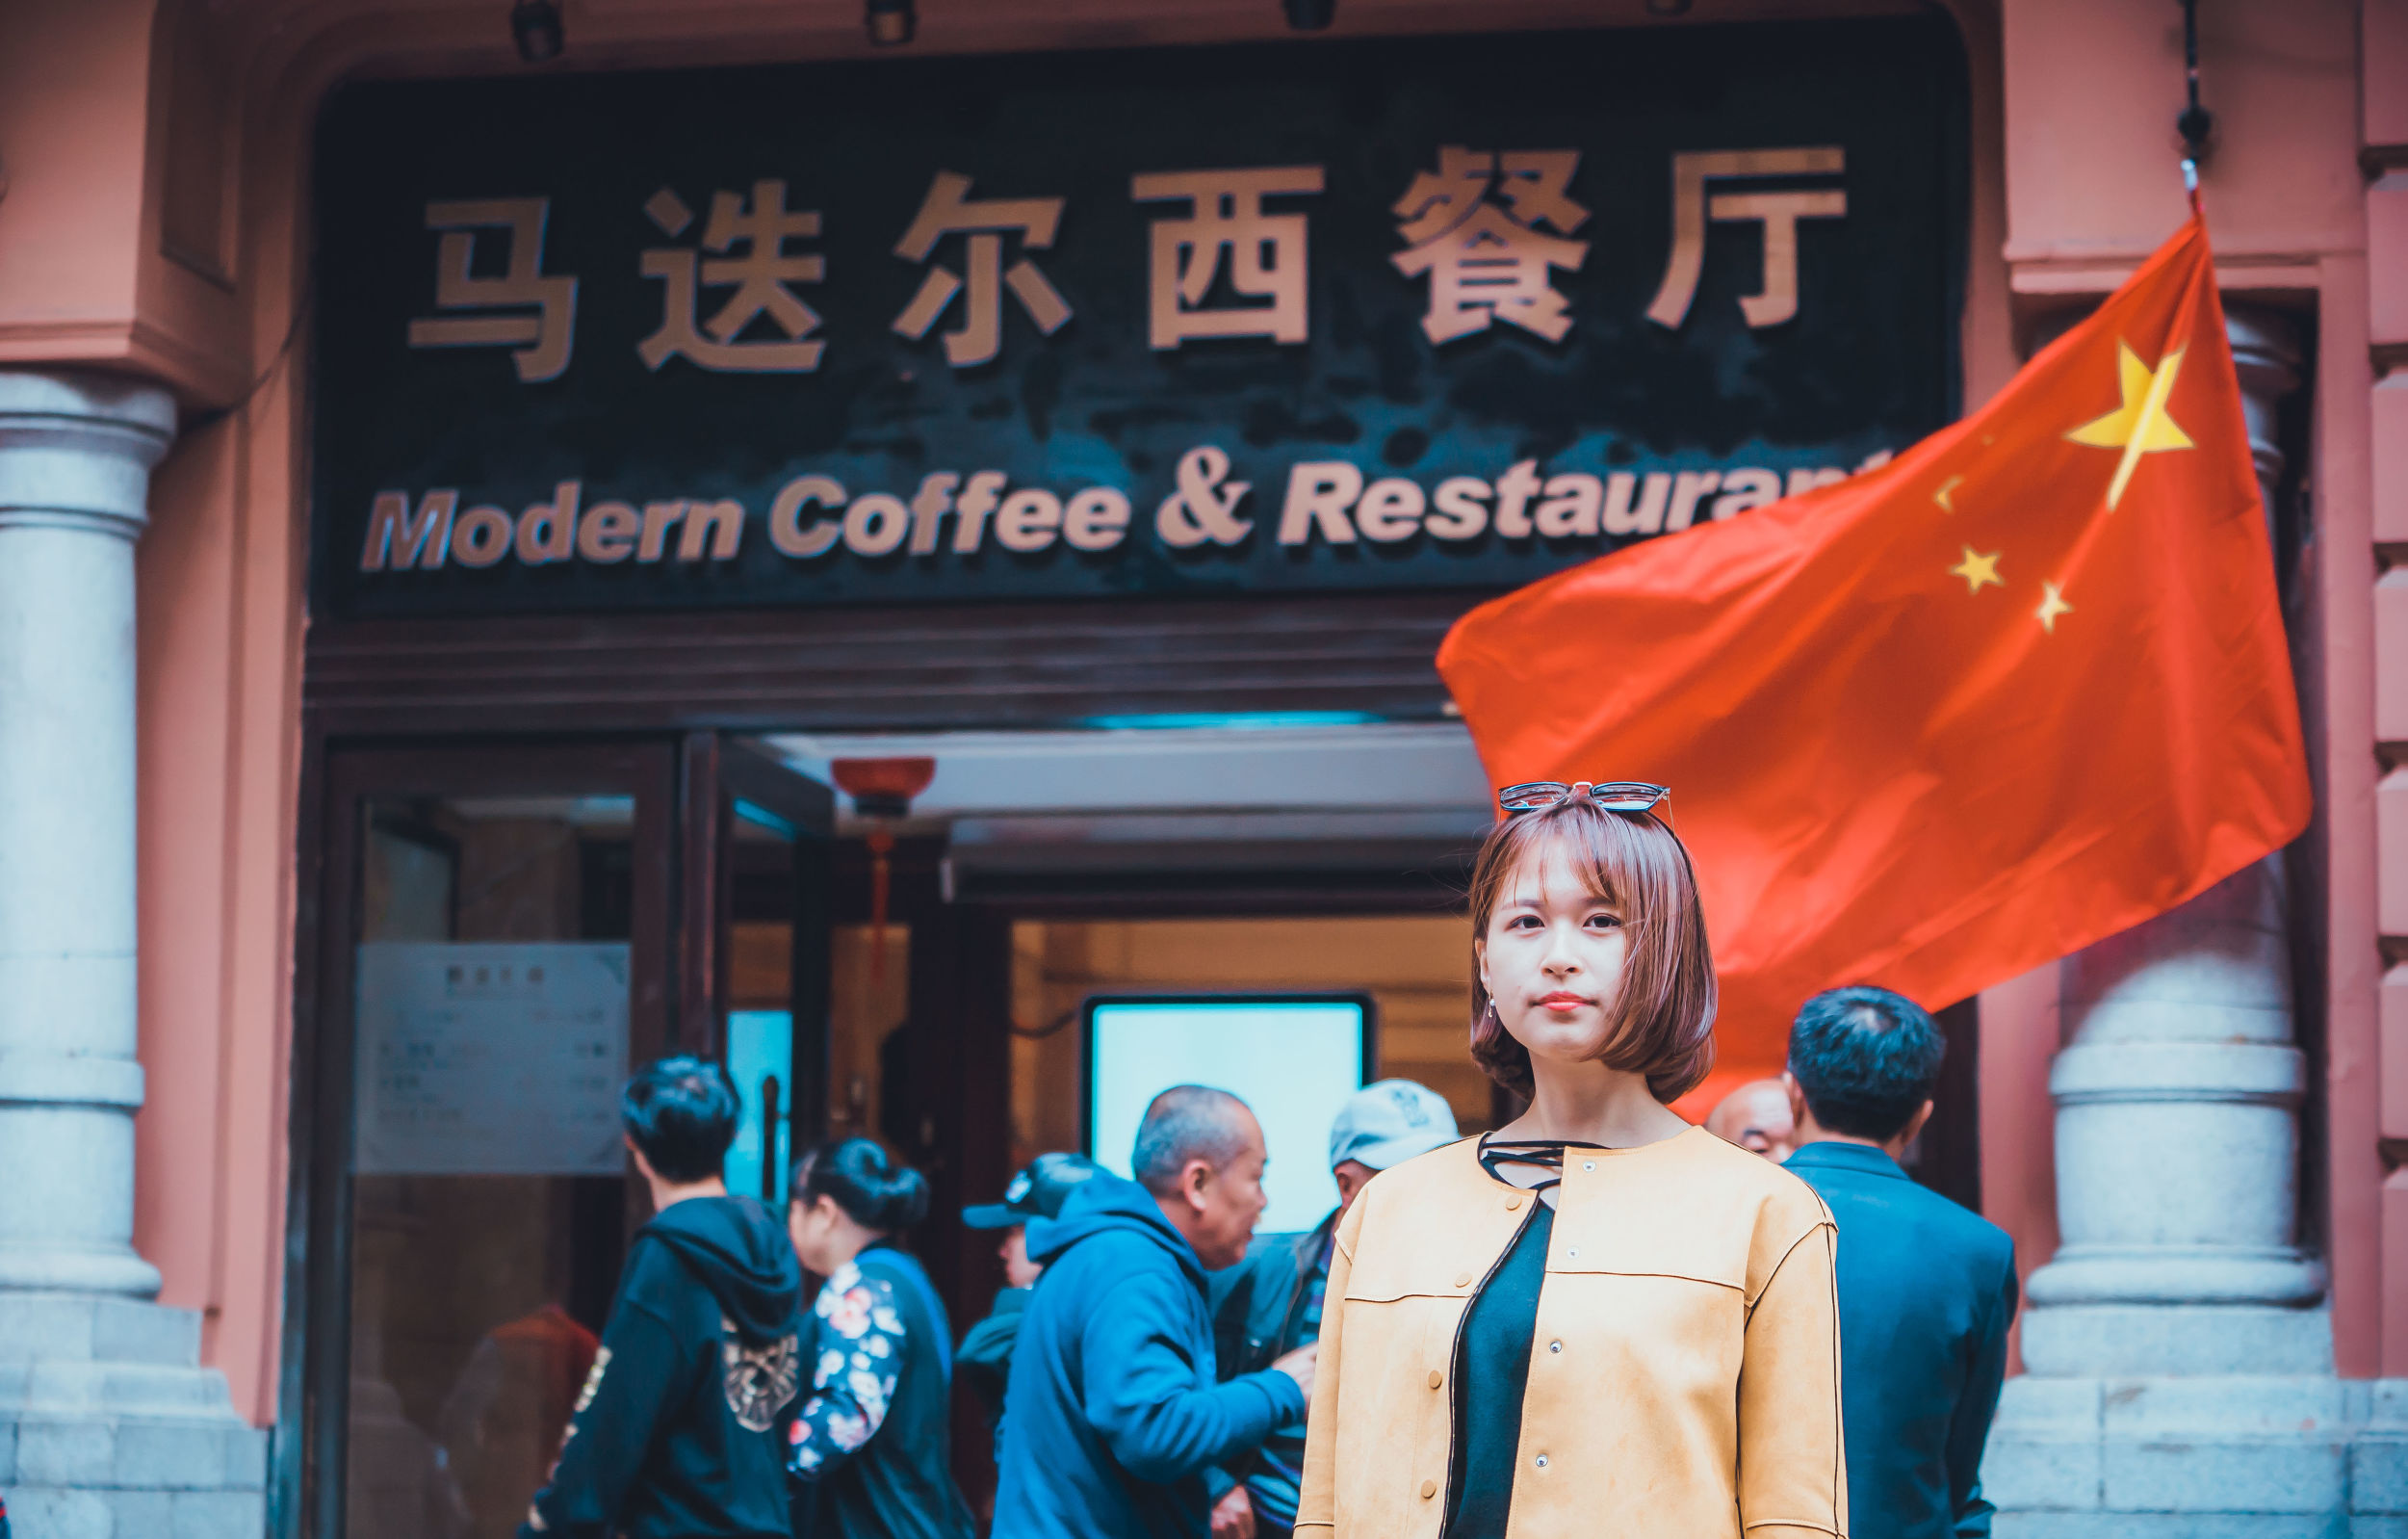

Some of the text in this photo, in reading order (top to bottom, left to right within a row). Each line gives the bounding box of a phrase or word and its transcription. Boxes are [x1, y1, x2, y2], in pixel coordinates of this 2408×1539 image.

[408, 146, 1847, 381] 马迭尔西餐厅
[360, 446, 1894, 570] Modern Coffee & Restaura
